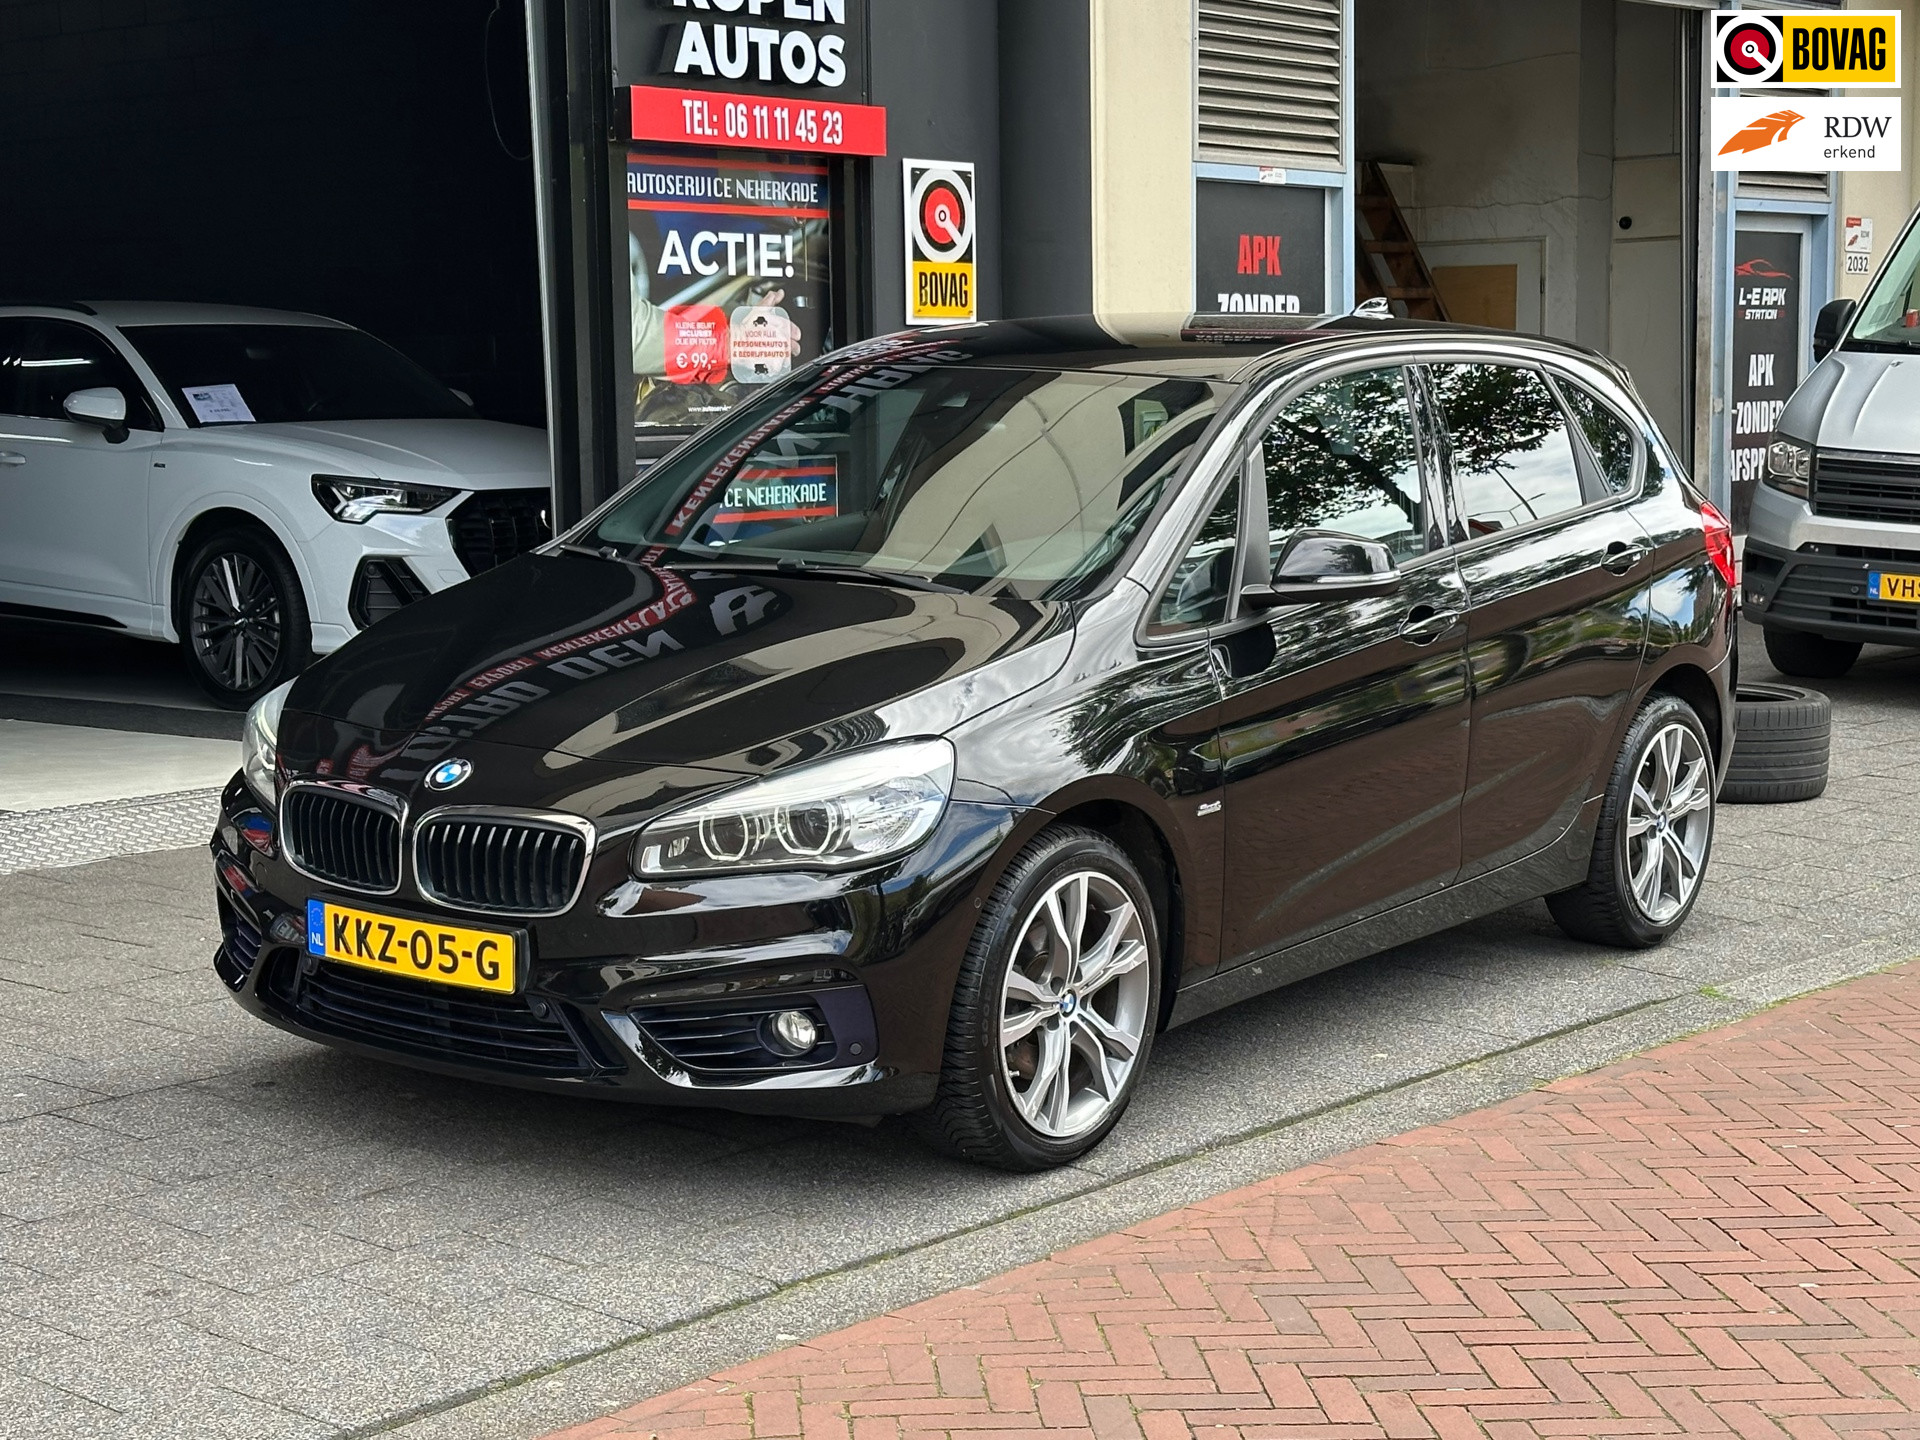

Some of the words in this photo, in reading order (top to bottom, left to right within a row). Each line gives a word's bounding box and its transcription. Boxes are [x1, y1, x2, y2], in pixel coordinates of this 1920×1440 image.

[674, 21, 846, 87] AUTOS
[682, 99, 718, 136] TEL:
[725, 102, 748, 138] 06
[753, 105, 769, 139] 11
[773, 107, 789, 141] 11
[795, 109, 818, 143] 45
[822, 110, 843, 145] 23
[627, 172, 732, 198] AUTOSERVICE
[736, 178, 818, 203] NEHERKADE
[657, 230, 794, 278] ACTIE!
[1237, 234, 1282, 276] APK
[1848, 256, 1868, 271] 2032
[919, 271, 968, 308] BOVAG
[1762, 287, 1786, 305] APK
[1745, 309, 1778, 320] STATION
[745, 330, 762, 338] VOOR
[763, 330, 777, 338] ALLE
[676, 353, 688, 368] €
[691, 353, 718, 370] 99,-
[1748, 354, 1774, 386] APK
[746, 483, 827, 507] NEHERKADE
[1870, 587, 1879, 595] NL
[1887, 577, 1920, 598] VH
[311, 931, 323, 946] NL
[333, 913, 500, 981] KKZ-05-G
